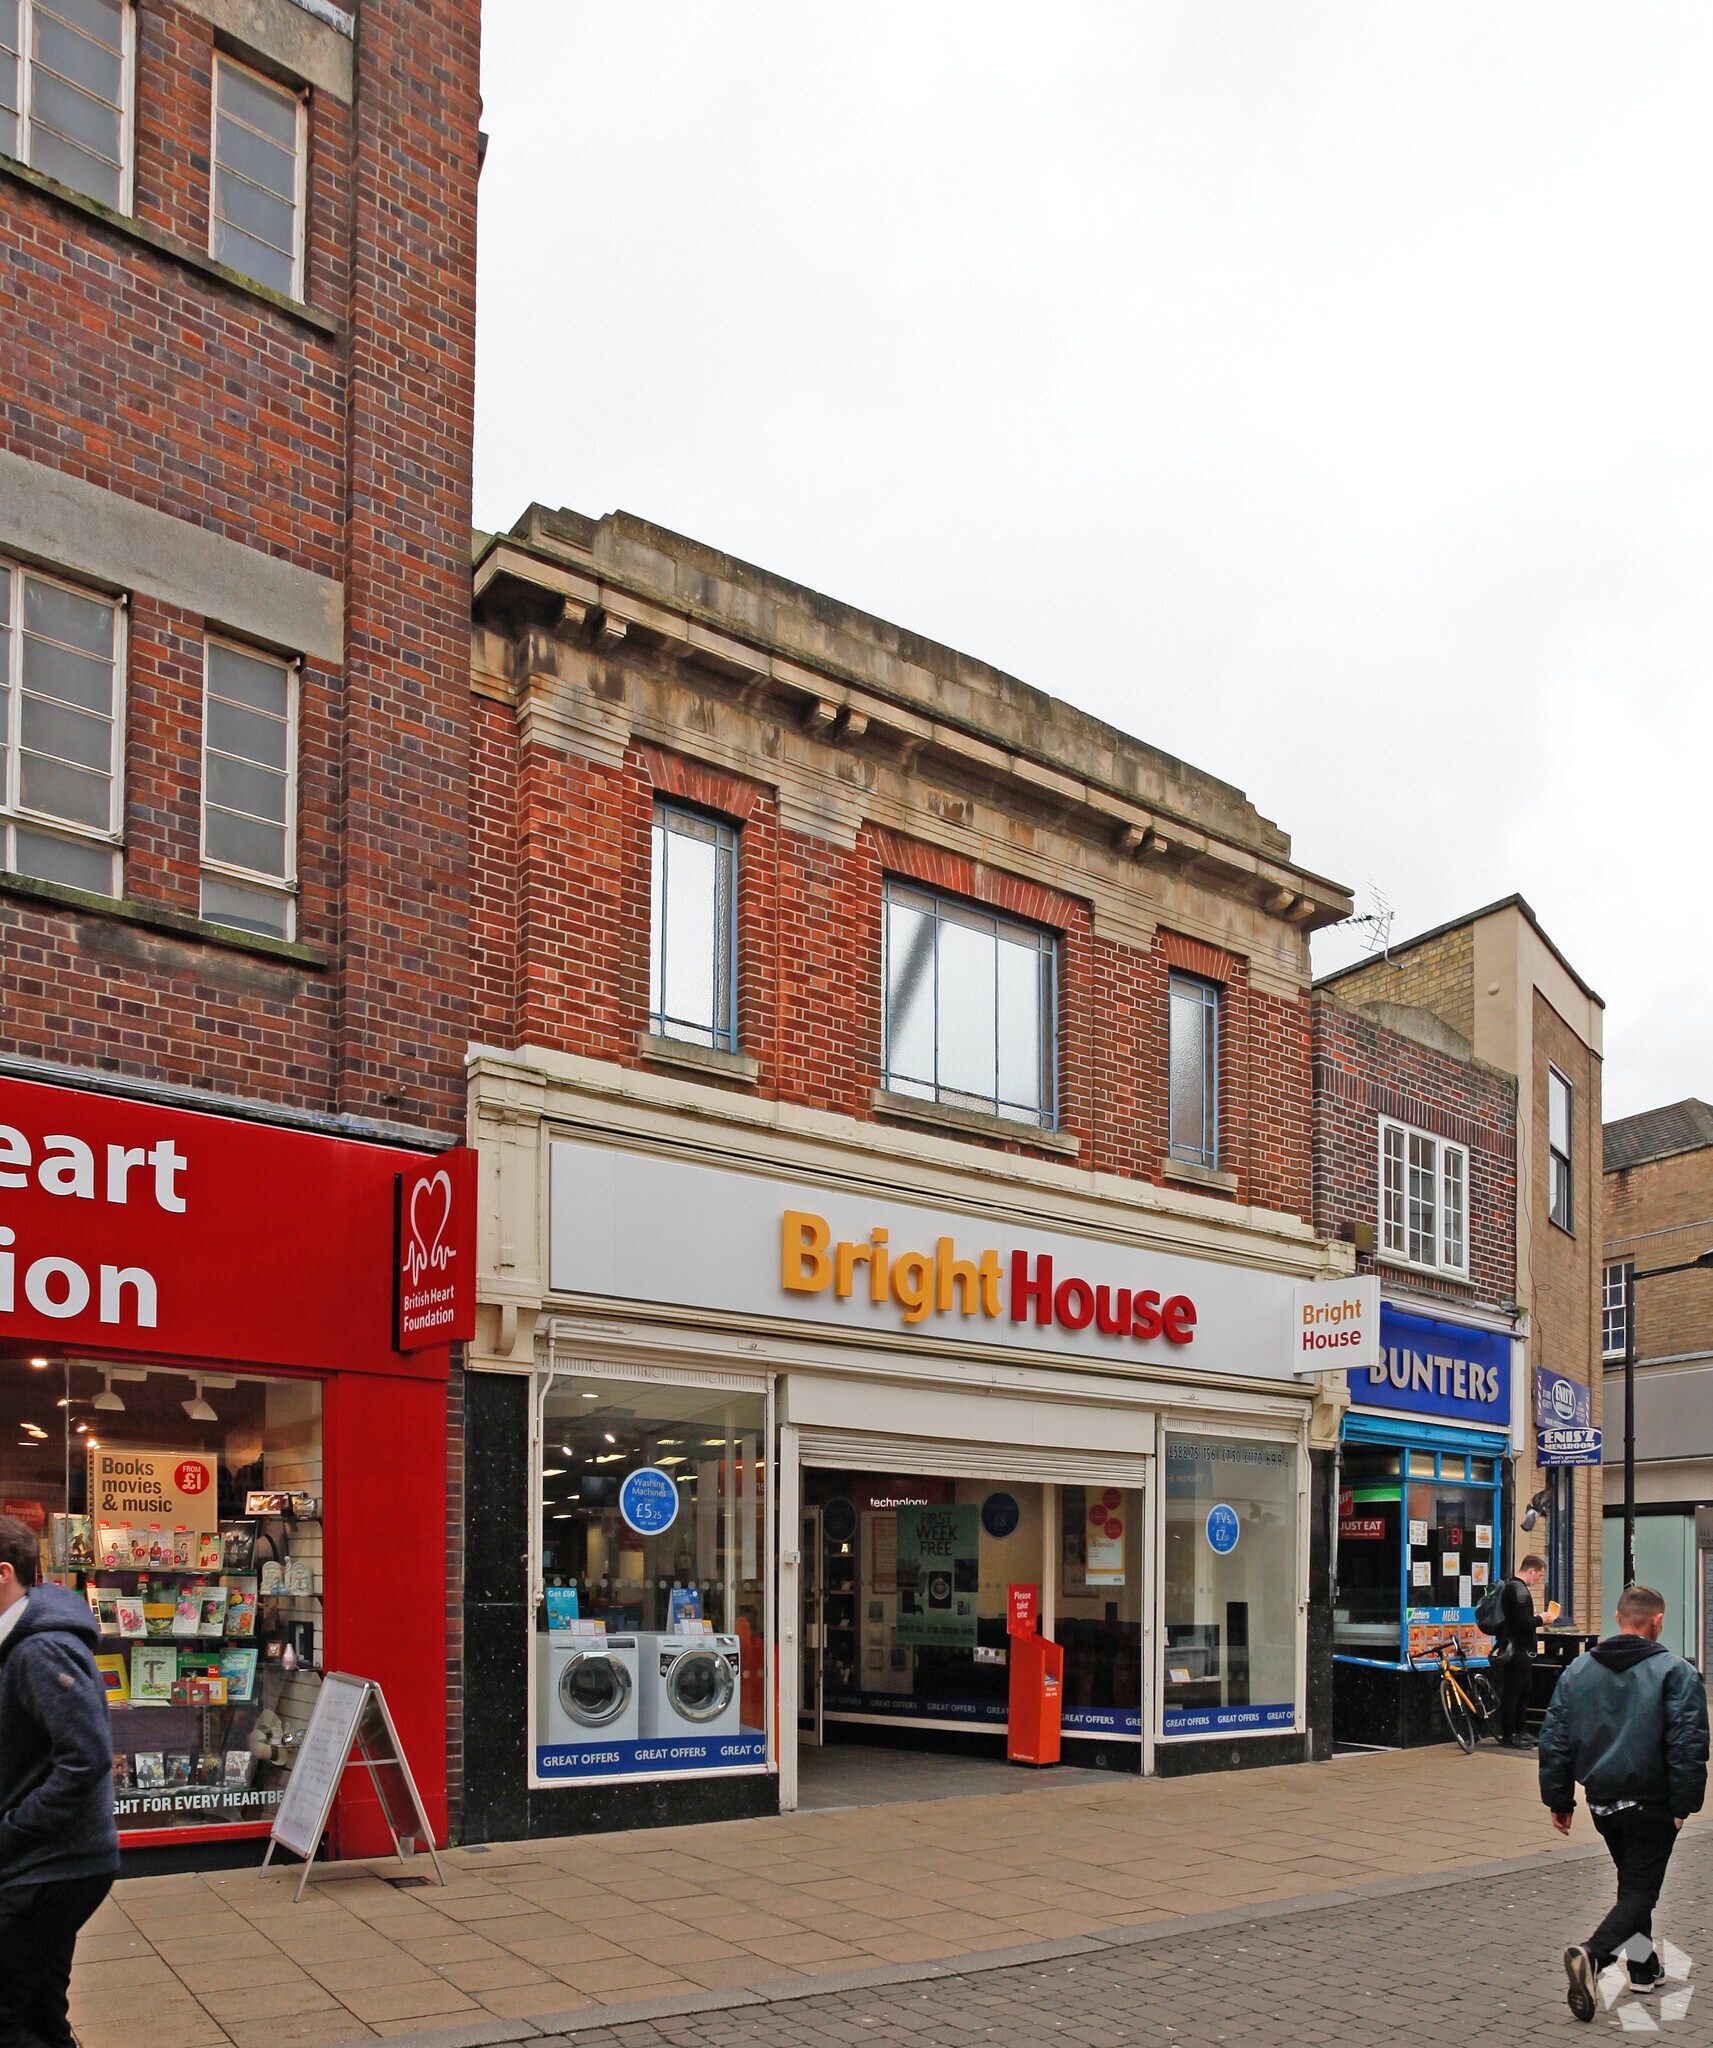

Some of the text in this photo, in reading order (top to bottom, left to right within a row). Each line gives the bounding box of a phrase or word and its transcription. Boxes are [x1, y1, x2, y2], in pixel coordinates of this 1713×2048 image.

[404, 1284, 454, 1311] British Heart
[1303, 1298, 1362, 1325] Bright
[404, 1306, 454, 1332] Foundation
[1303, 1330, 1362, 1351] House
[1369, 1346, 1499, 1403] BUNTERS
[1544, 1430, 1595, 1443] ENIS'Z
[102, 1457, 154, 1476] Books
[183, 1465, 201, 1473] FROM
[102, 1477, 162, 1495] movies
[182, 1473, 201, 1490] £1
[634, 1478, 666, 1490] Washing
[632, 1487, 667, 1498] Machines
[102, 1494, 172, 1513] & music
[636, 1503, 662, 1519] £5.25
[920, 1511, 952, 1525] FIRST
[1214, 1512, 1231, 1524] TVs
[1340, 1521, 1382, 1531] JUST EAT
[916, 1525, 958, 1541] WEEK
[919, 1541, 952, 1556] FREE
[548, 1590, 575, 1598] Get £50
[1014, 1591, 1032, 1601] Please
[1016, 1601, 1029, 1610] take
[1017, 1610, 1028, 1619] one
[1442, 1610, 1460, 1622] MEALS
[892, 1701, 918, 1710] OFFERS
[927, 1702, 977, 1713] GREAT OFFERS
[1086, 1714, 1115, 1725] OFFERS
[1165, 1716, 1210, 1728] GREAT OFFERS
[1217, 1713, 1260, 1724] GREAT OFFERS
[1267, 1711, 1286, 1721] GREAT
[634, 1747, 707, 1760] GREAT OFFERS
[720, 1745, 752, 1756] GREAT
[543, 1752, 620, 1767] GREAT OFFERS
[143, 1798, 171, 1813] FOR
[175, 1793, 220, 1810] EVERY
